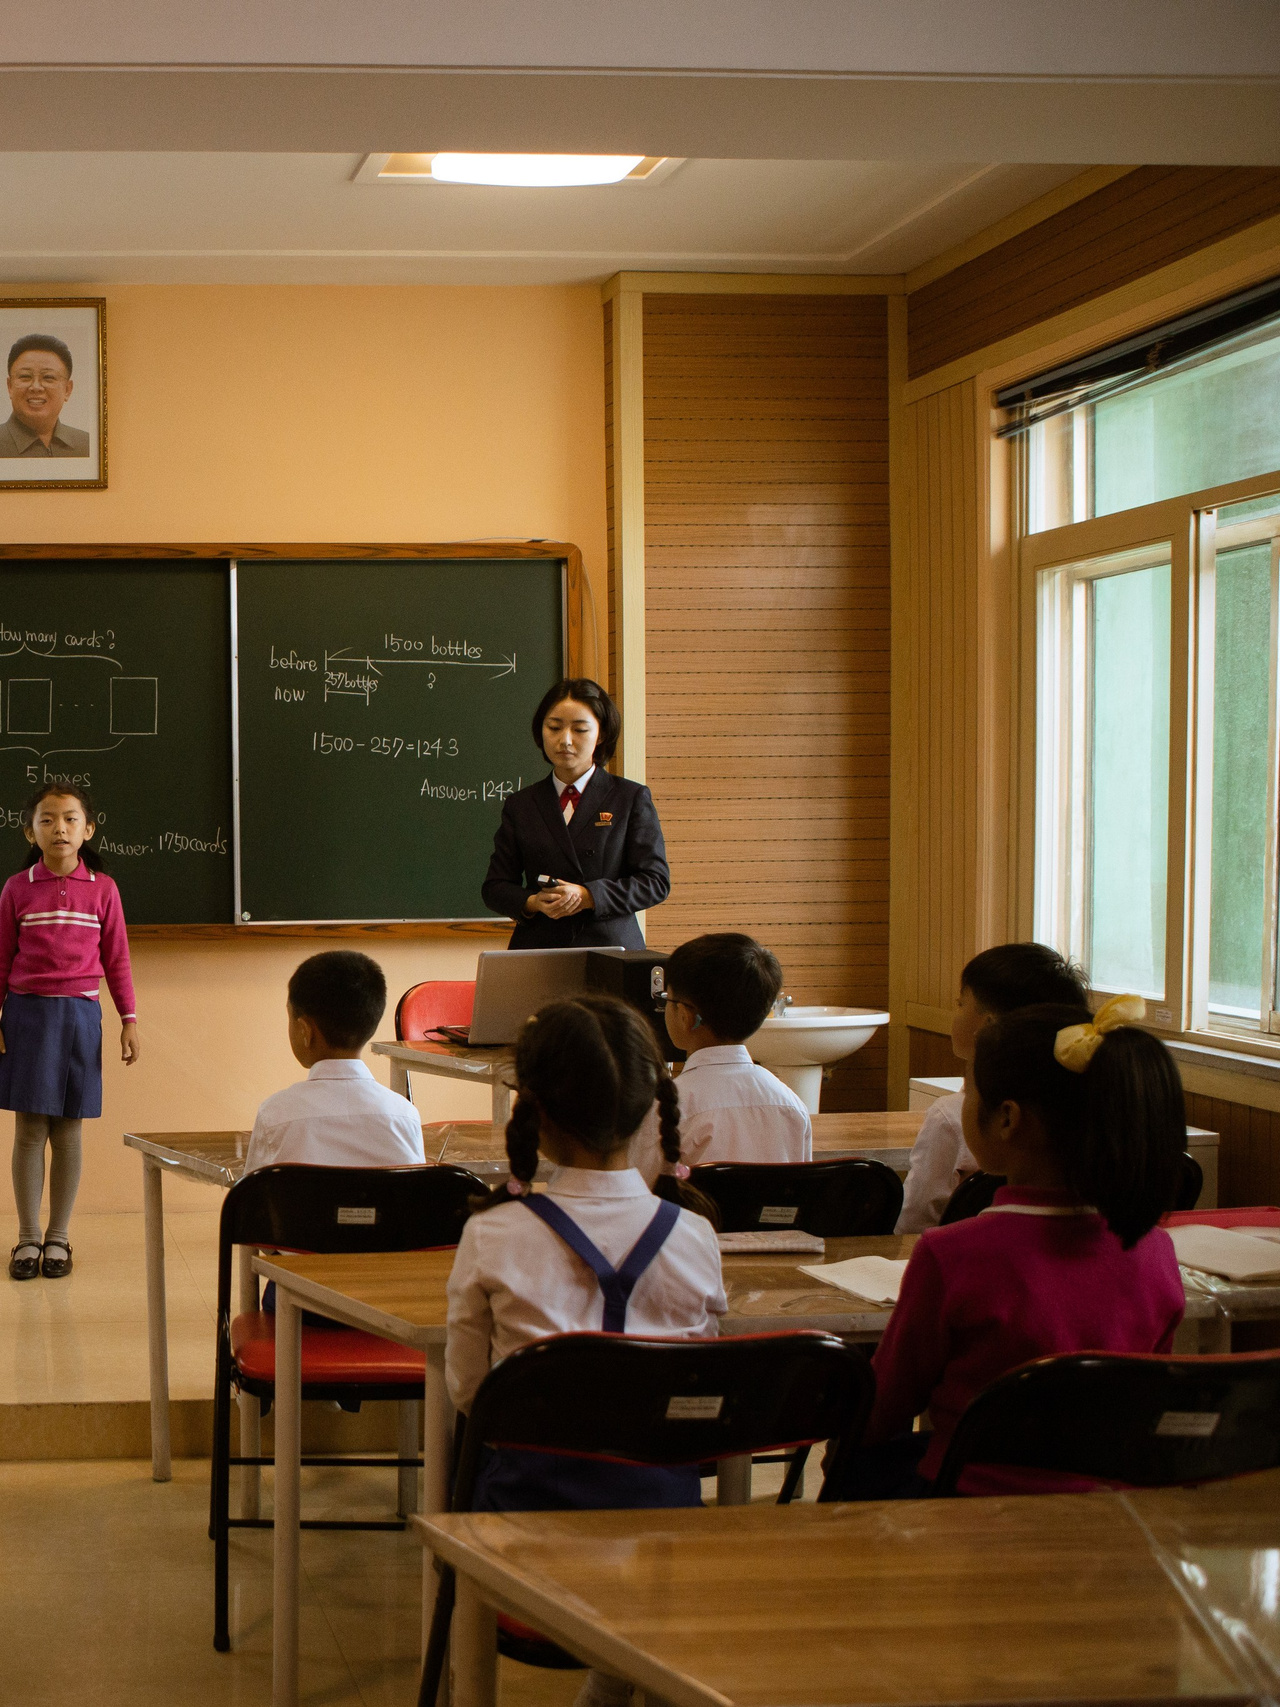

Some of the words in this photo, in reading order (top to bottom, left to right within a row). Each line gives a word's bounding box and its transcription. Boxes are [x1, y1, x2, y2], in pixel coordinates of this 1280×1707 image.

[26, 631, 57, 655] many
[385, 634, 423, 652] 1500
[432, 635, 483, 658] bottles
[269, 645, 318, 671] before
[427, 673, 436, 689] ?
[274, 686, 305, 702] now
[26, 765, 39, 783] 5
[43, 764, 91, 787] boxes
